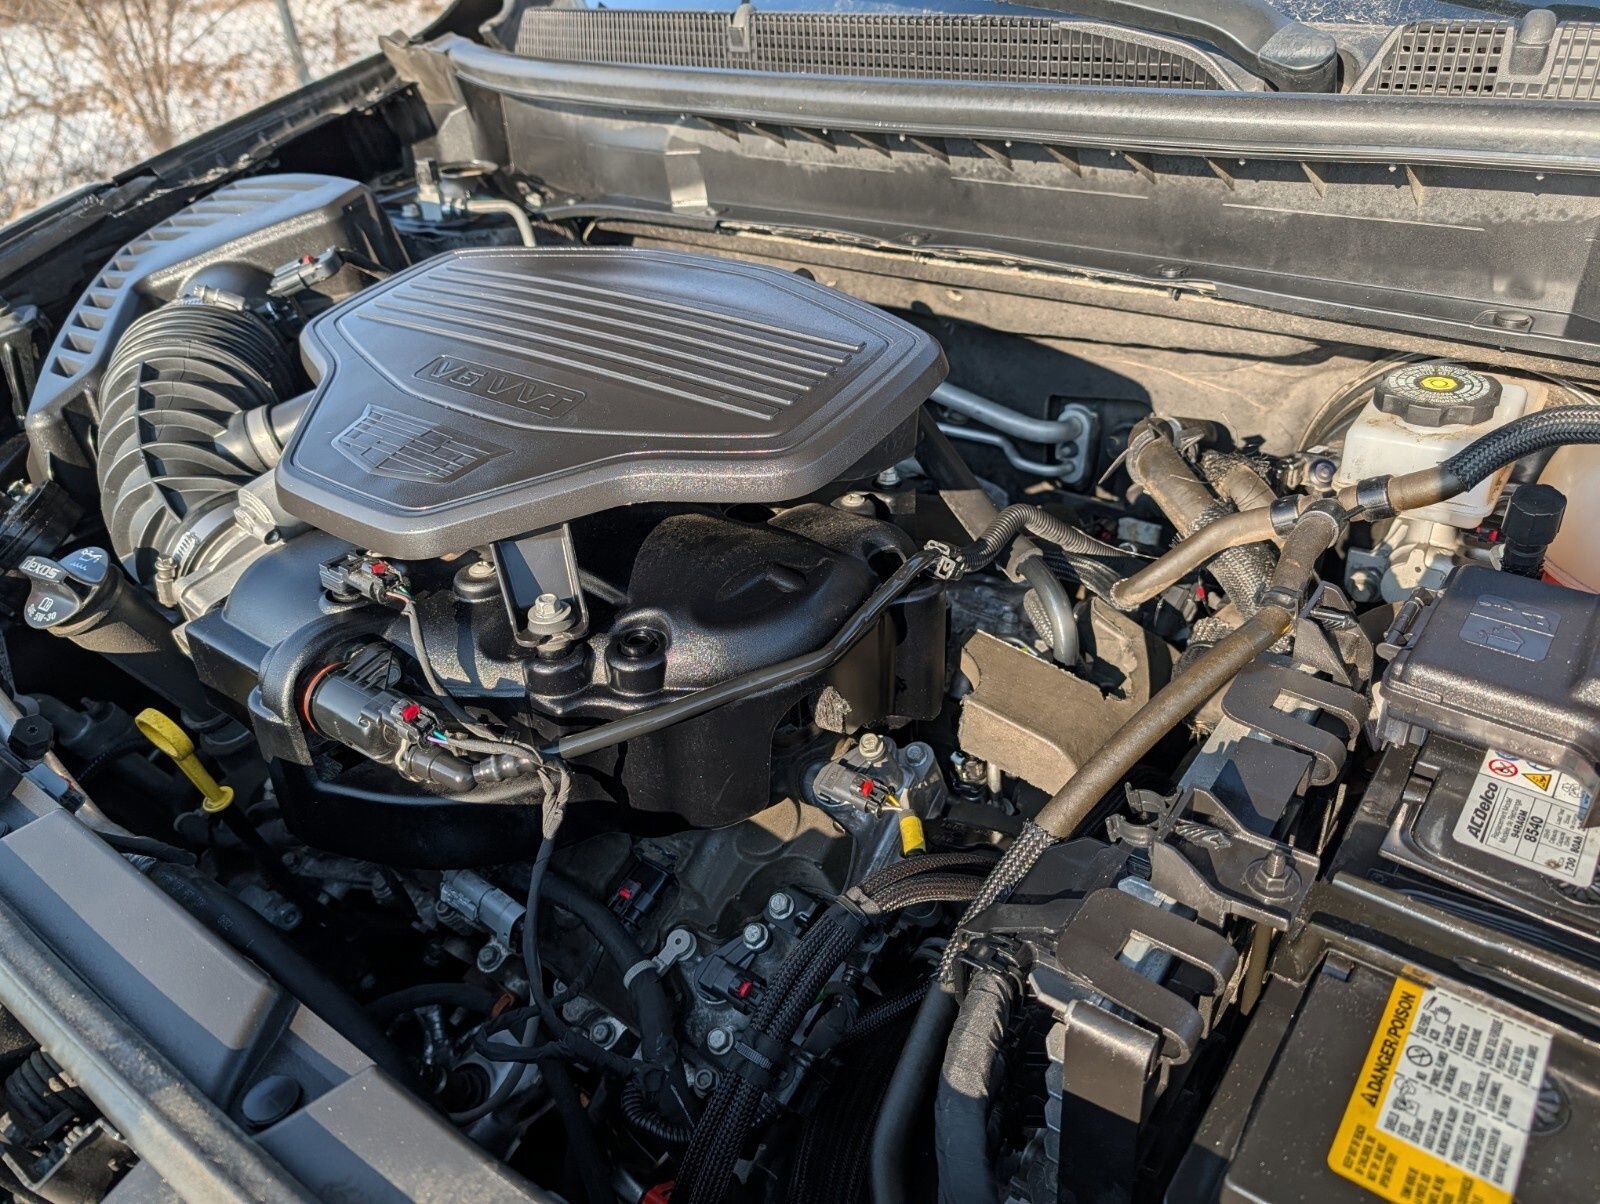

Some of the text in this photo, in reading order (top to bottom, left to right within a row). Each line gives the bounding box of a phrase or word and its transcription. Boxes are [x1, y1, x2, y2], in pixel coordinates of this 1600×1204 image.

[431, 361, 572, 410] V6 VVT
[22, 558, 60, 579] dexos
[1466, 782, 1498, 839] ACDelco
[1510, 809, 1528, 839] 94RAGM
[1523, 815, 1544, 843] 8540
[1564, 856, 1576, 872] 730
[1368, 991, 1416, 1097] DANGER/POISON
